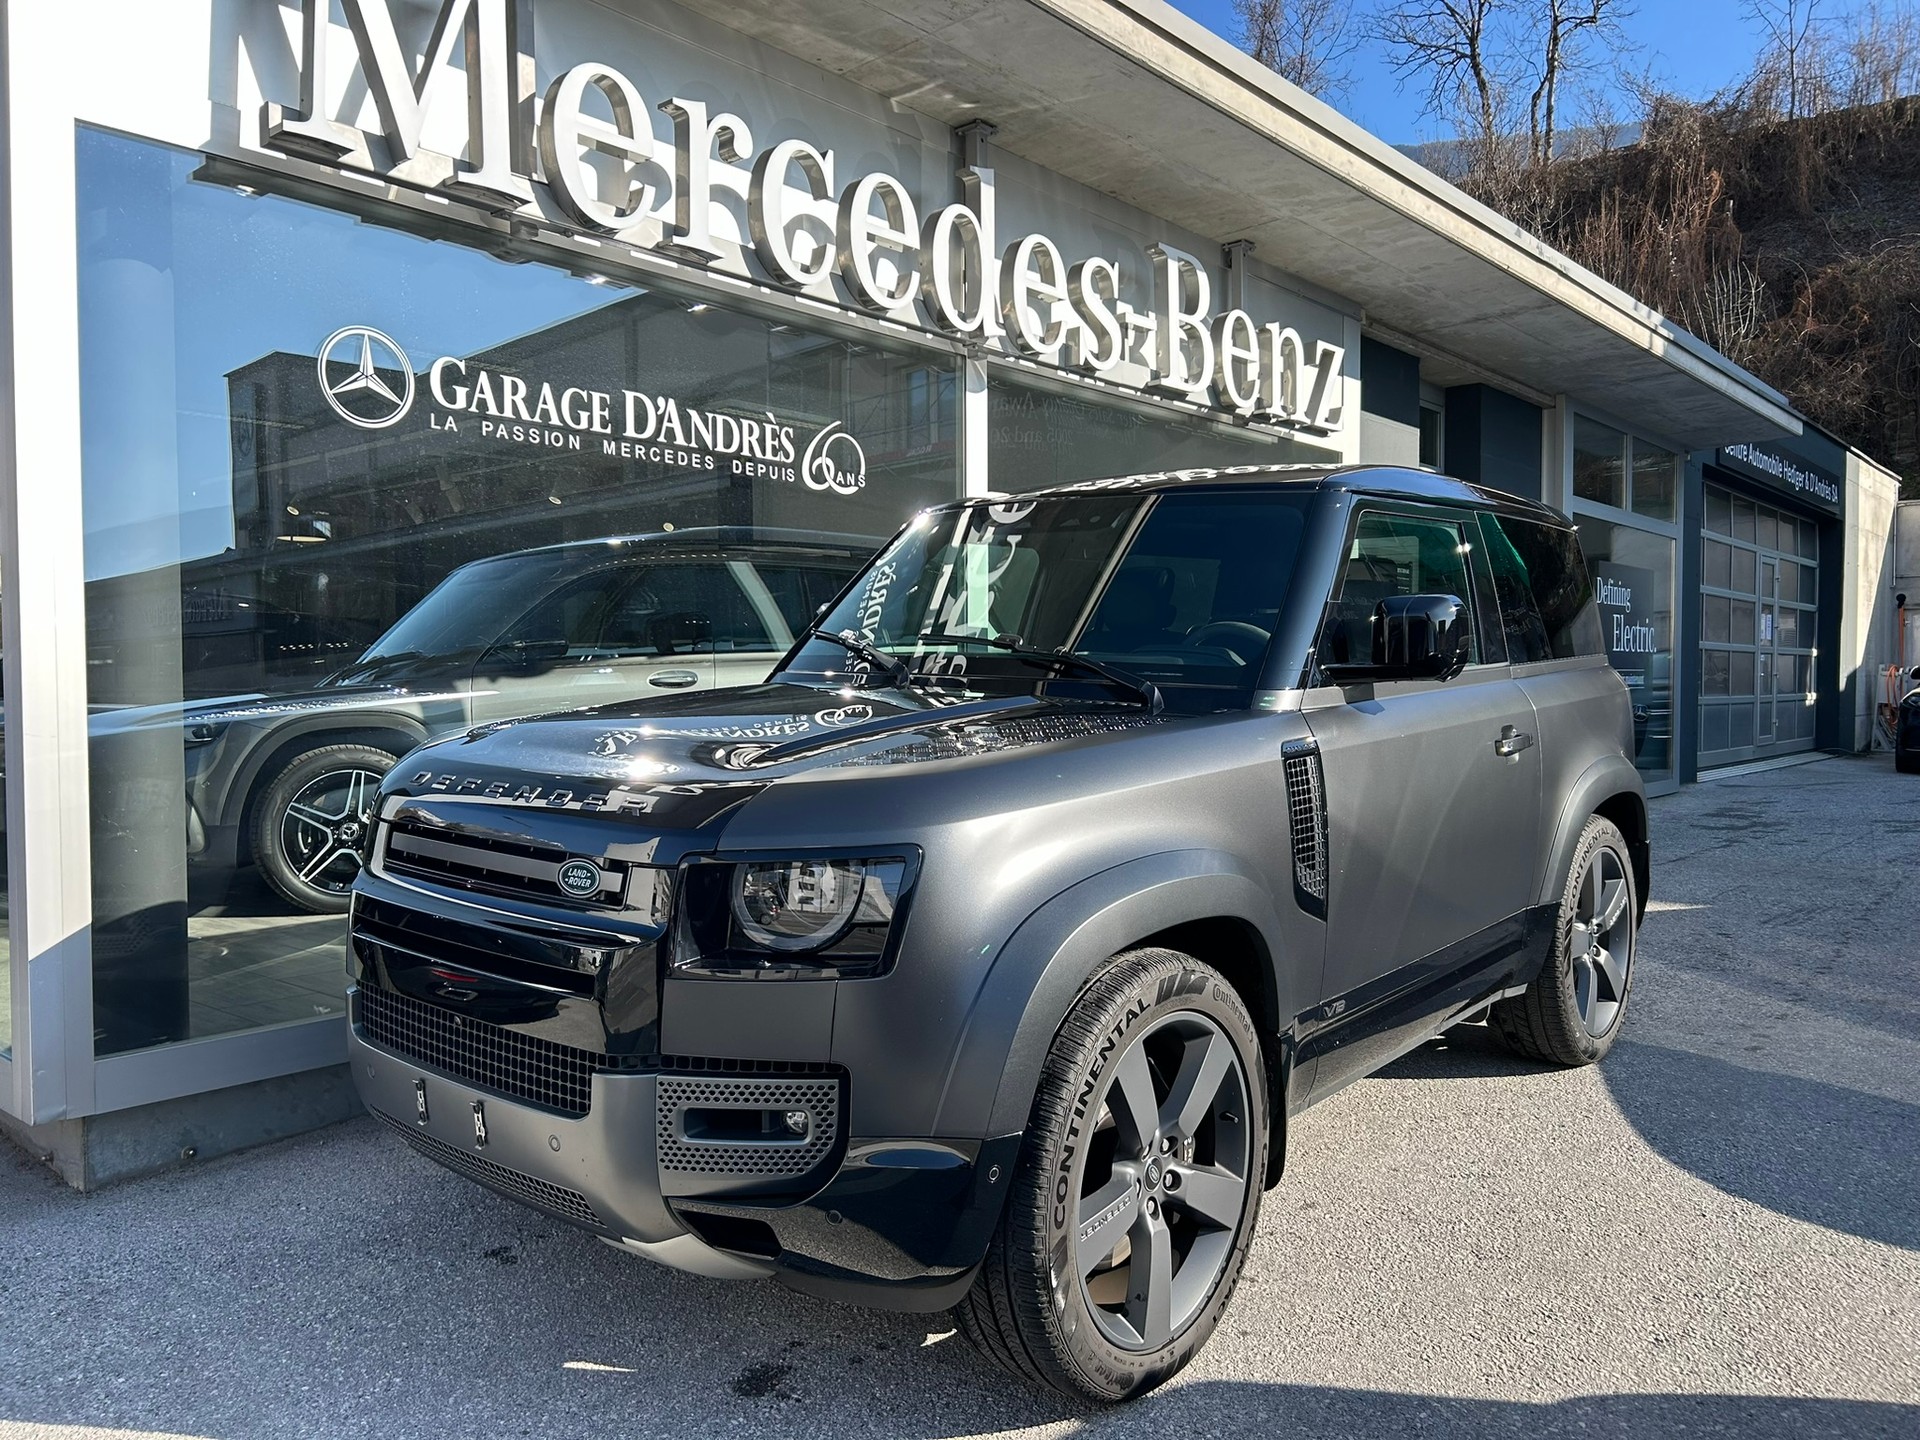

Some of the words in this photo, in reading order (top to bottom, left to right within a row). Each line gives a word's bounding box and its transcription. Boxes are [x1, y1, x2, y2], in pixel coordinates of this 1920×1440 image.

[262, 0, 1345, 433] Mercedes-Benz
[430, 356, 612, 435] GARAGE
[622, 389, 796, 464] D'ANDRÈS
[430, 413, 458, 432] LA
[482, 420, 581, 450] PASSION
[603, 440, 715, 470] MERCEDES
[733, 460, 796, 482] DEPUIS
[1748, 443, 1783, 478] Automobile
[1783, 460, 1805, 490] Hediger
[1831, 484, 1839, 503] SA
[836, 472, 866, 488] ANS
[1596, 577, 1631, 612] Defining
[1612, 614, 1657, 653] Electric.
[409, 771, 648, 816] DEFENDER
[1569, 826, 1610, 912] CONTINENTAL
[1212, 983, 1252, 1033] Continental
[1054, 997, 1151, 1231] CONTINENTAL
[1080, 1195, 1132, 1243] DEFENDER
